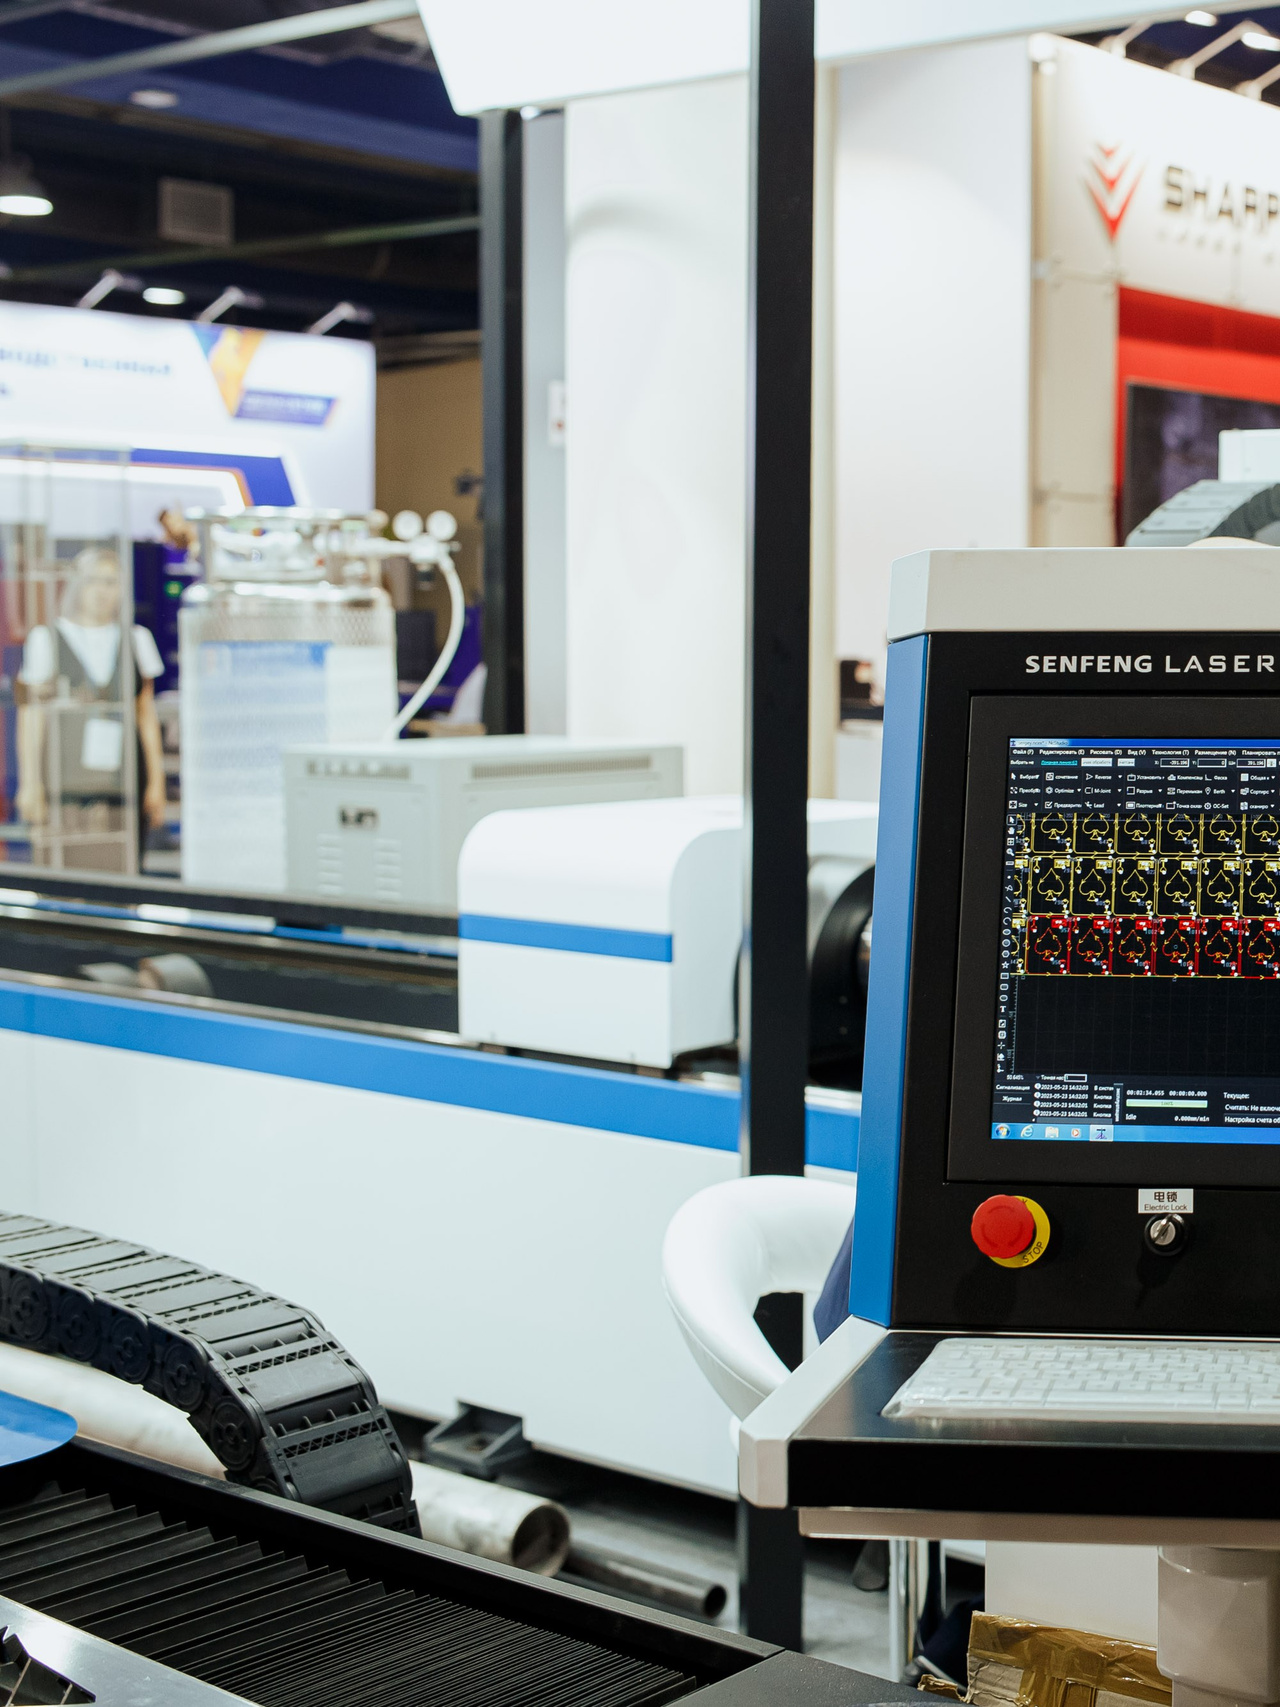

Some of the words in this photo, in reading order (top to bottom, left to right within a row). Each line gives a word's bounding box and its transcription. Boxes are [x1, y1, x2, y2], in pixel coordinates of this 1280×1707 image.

[1164, 165, 1280, 236] SHARP
[1026, 655, 1152, 673] SENFENG
[1166, 655, 1274, 673] LASER
[1154, 1192, 1178, 1203] 电锁
[1023, 1242, 1043, 1263] STOP
